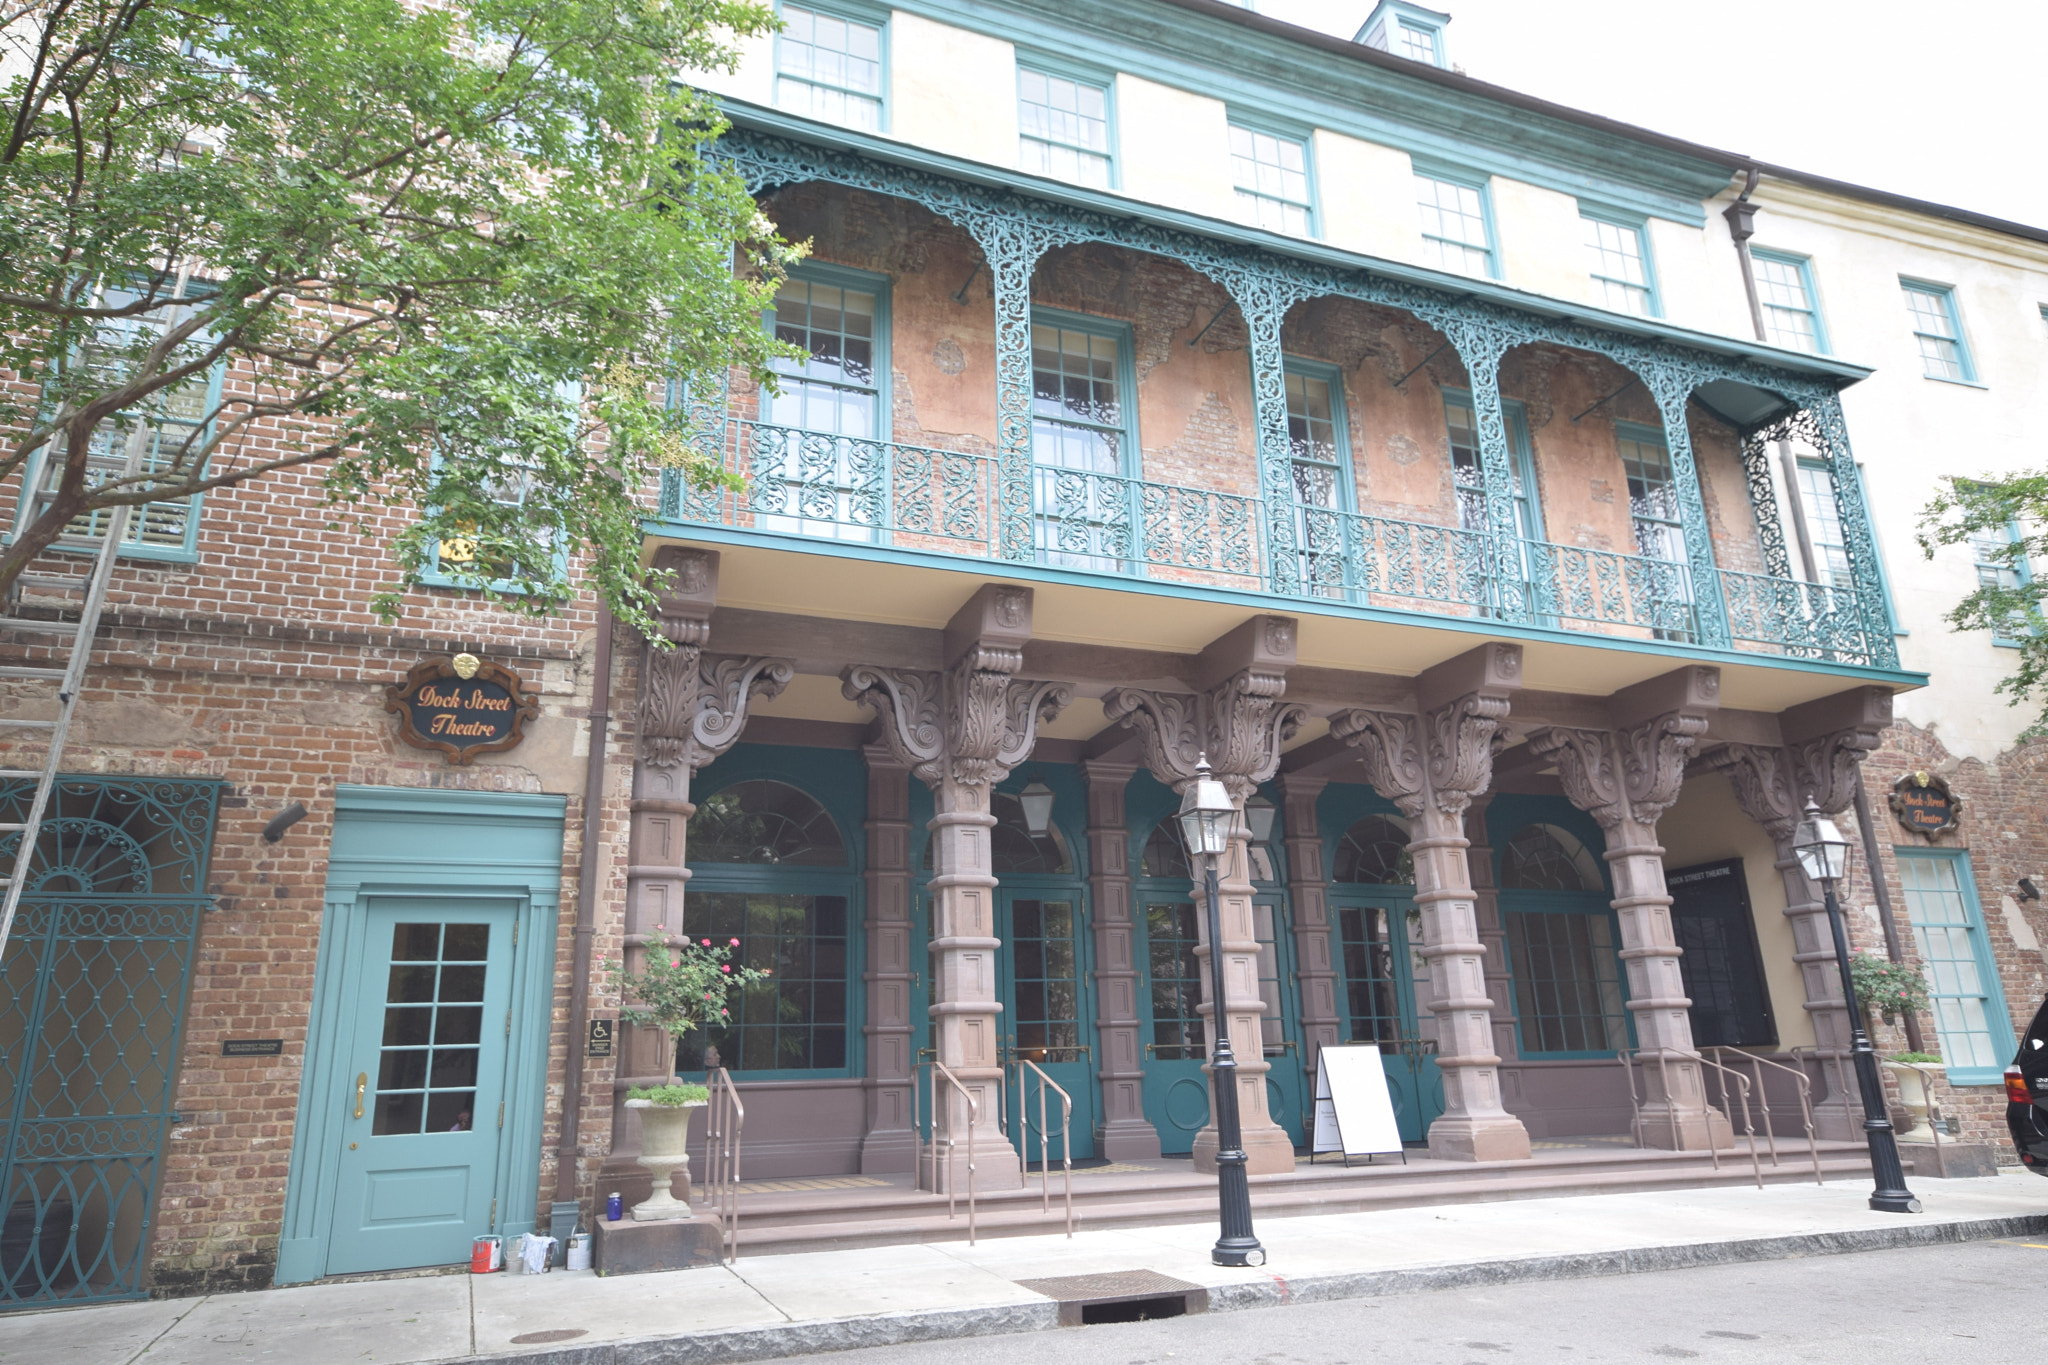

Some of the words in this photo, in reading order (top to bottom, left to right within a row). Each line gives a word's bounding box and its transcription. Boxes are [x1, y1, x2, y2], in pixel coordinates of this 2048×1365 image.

[417, 685, 462, 709] Dock
[464, 689, 512, 711] Street
[430, 713, 497, 737] Theatre
[1913, 809, 1944, 824] Theatre
[1684, 872, 1705, 883] STREET
[1705, 867, 1731, 878] THEATRE
